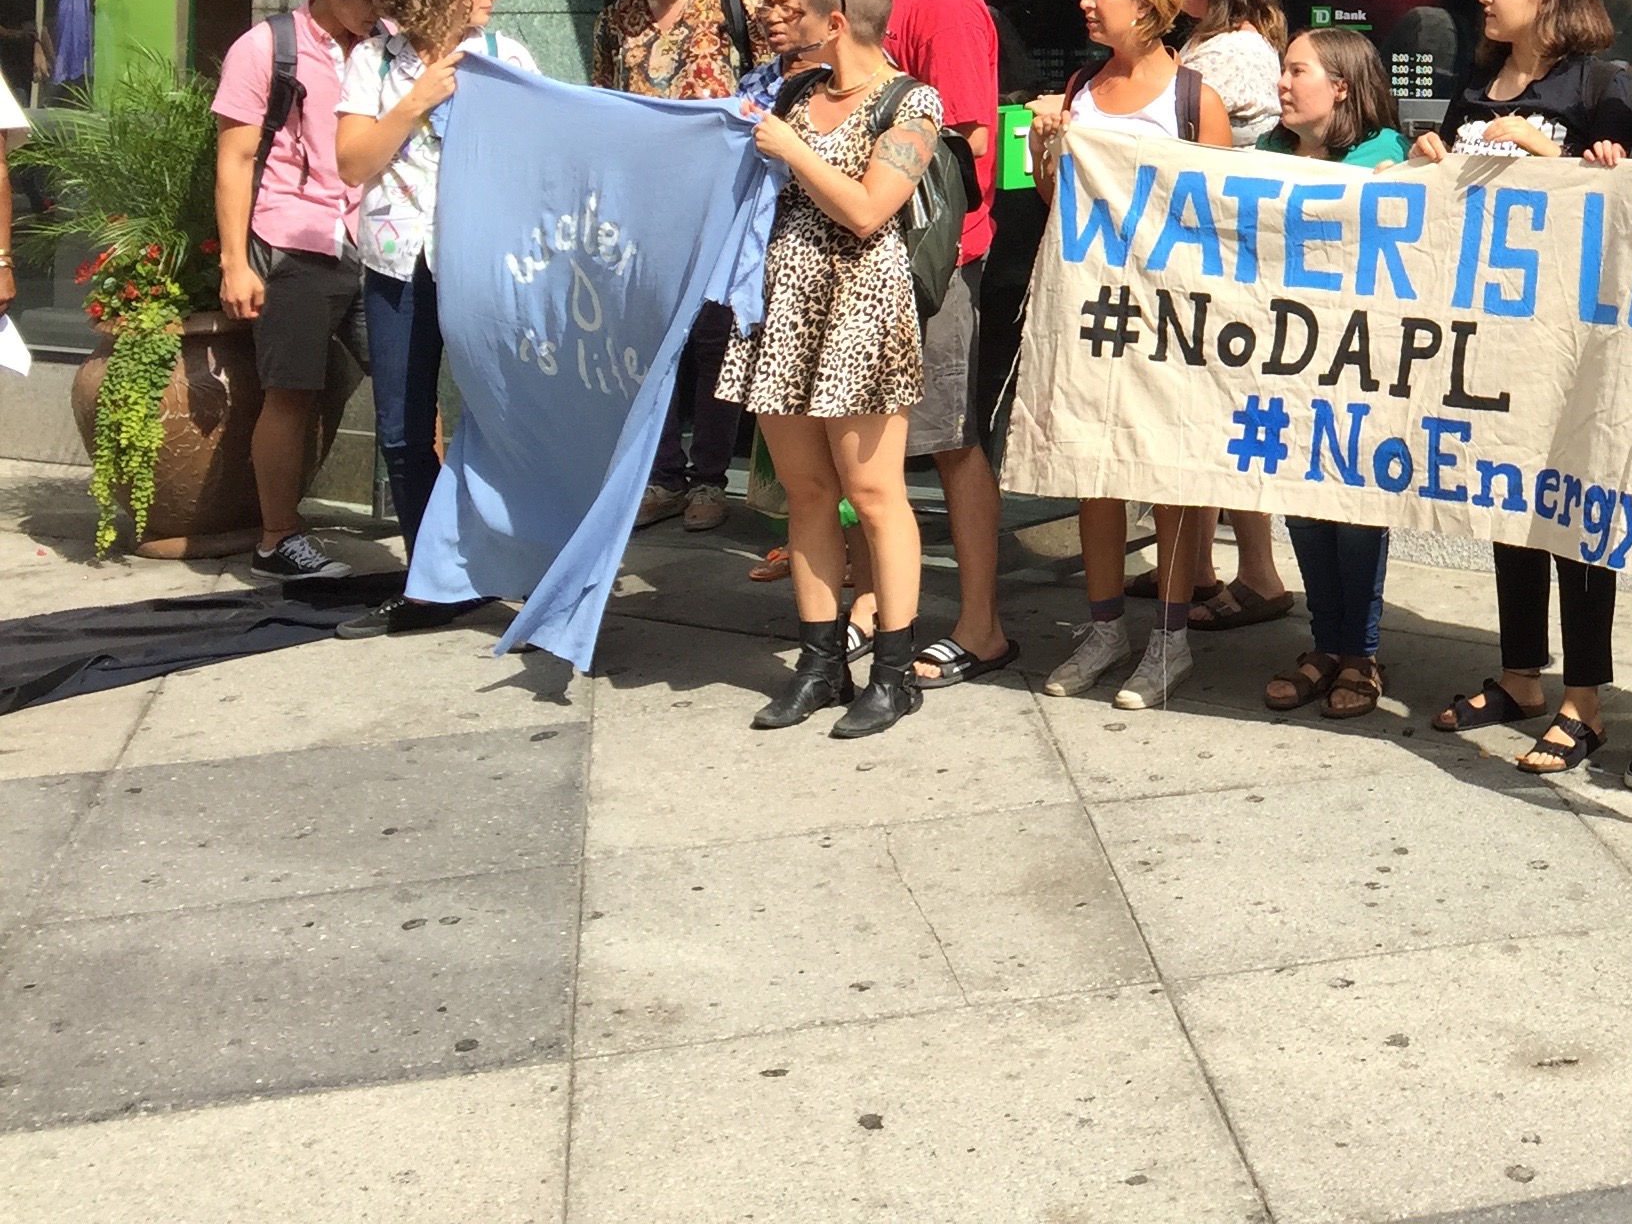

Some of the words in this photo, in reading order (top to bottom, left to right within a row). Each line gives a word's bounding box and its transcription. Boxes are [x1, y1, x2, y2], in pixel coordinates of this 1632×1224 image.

[1312, 9, 1331, 24] TD
[1334, 9, 1367, 21] Bank
[1058, 153, 1426, 301] WATER
[1451, 185, 1548, 319] IS
[1080, 284, 1511, 413] #NoDAPL
